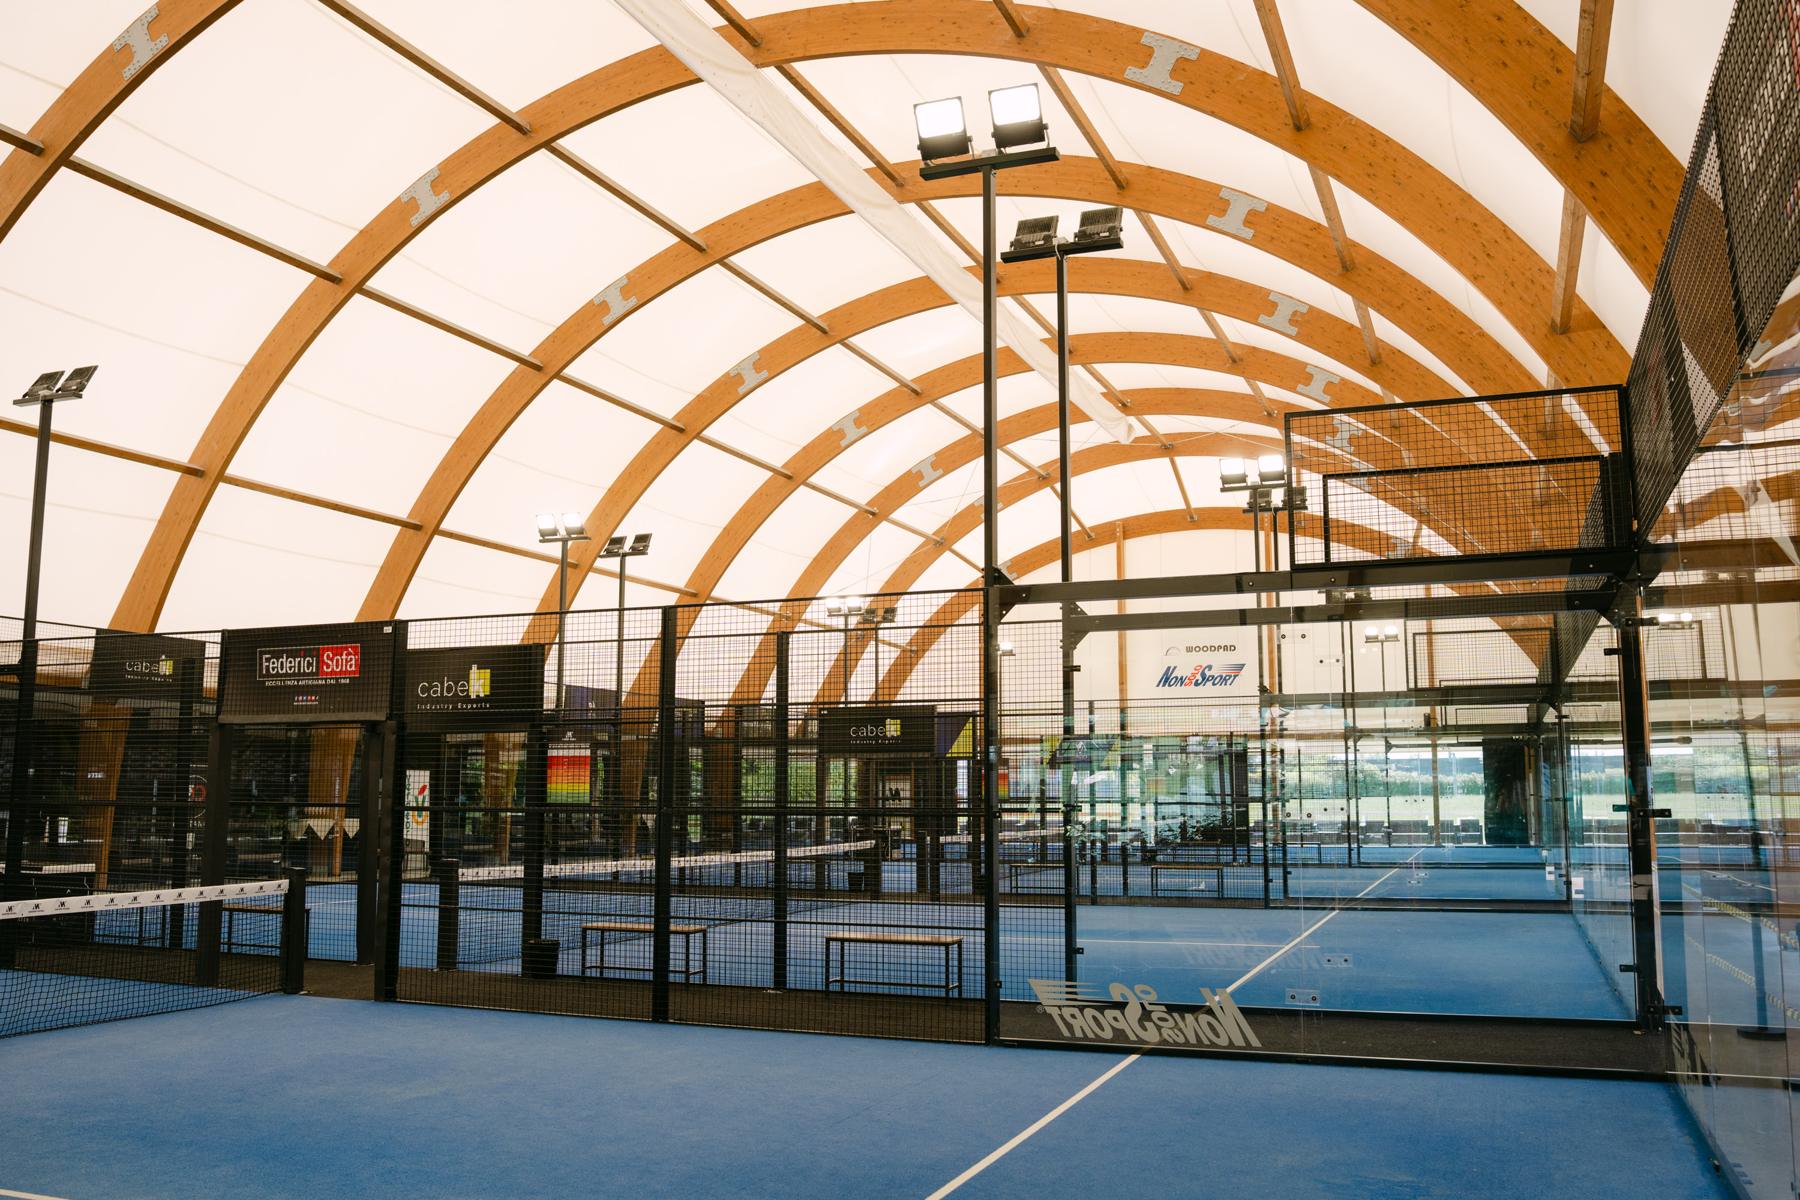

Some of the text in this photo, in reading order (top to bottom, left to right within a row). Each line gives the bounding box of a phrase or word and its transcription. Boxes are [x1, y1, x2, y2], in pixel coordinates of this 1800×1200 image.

[262, 648, 356, 675] Federici Sofà
[1185, 644, 1237, 653] WOODPAD
[417, 664, 490, 700] cabek
